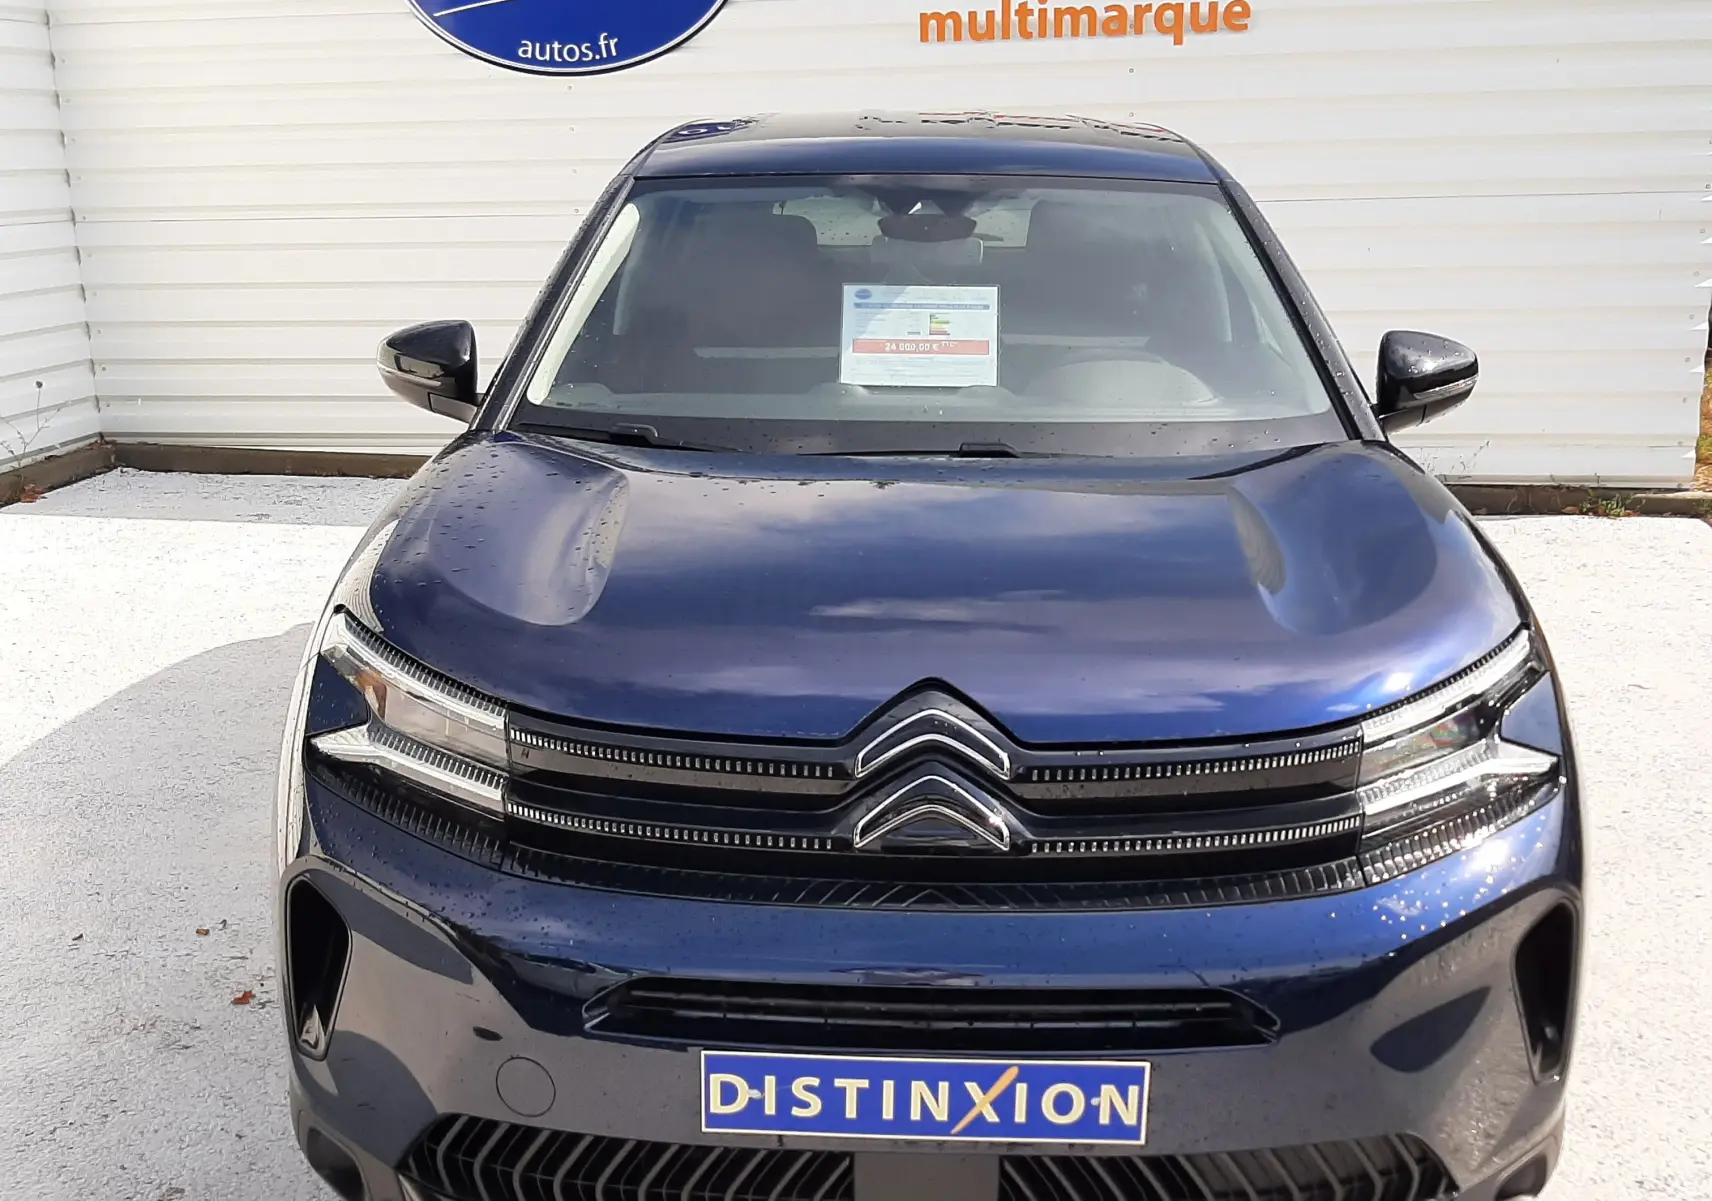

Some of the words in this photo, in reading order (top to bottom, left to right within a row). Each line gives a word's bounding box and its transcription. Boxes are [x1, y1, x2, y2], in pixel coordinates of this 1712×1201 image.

[919, 0, 1251, 46] multimarque
[517, 32, 618, 62] autos.fr
[885, 342, 897, 352] 24
[709, 1065, 1140, 1135] DISTINXION
